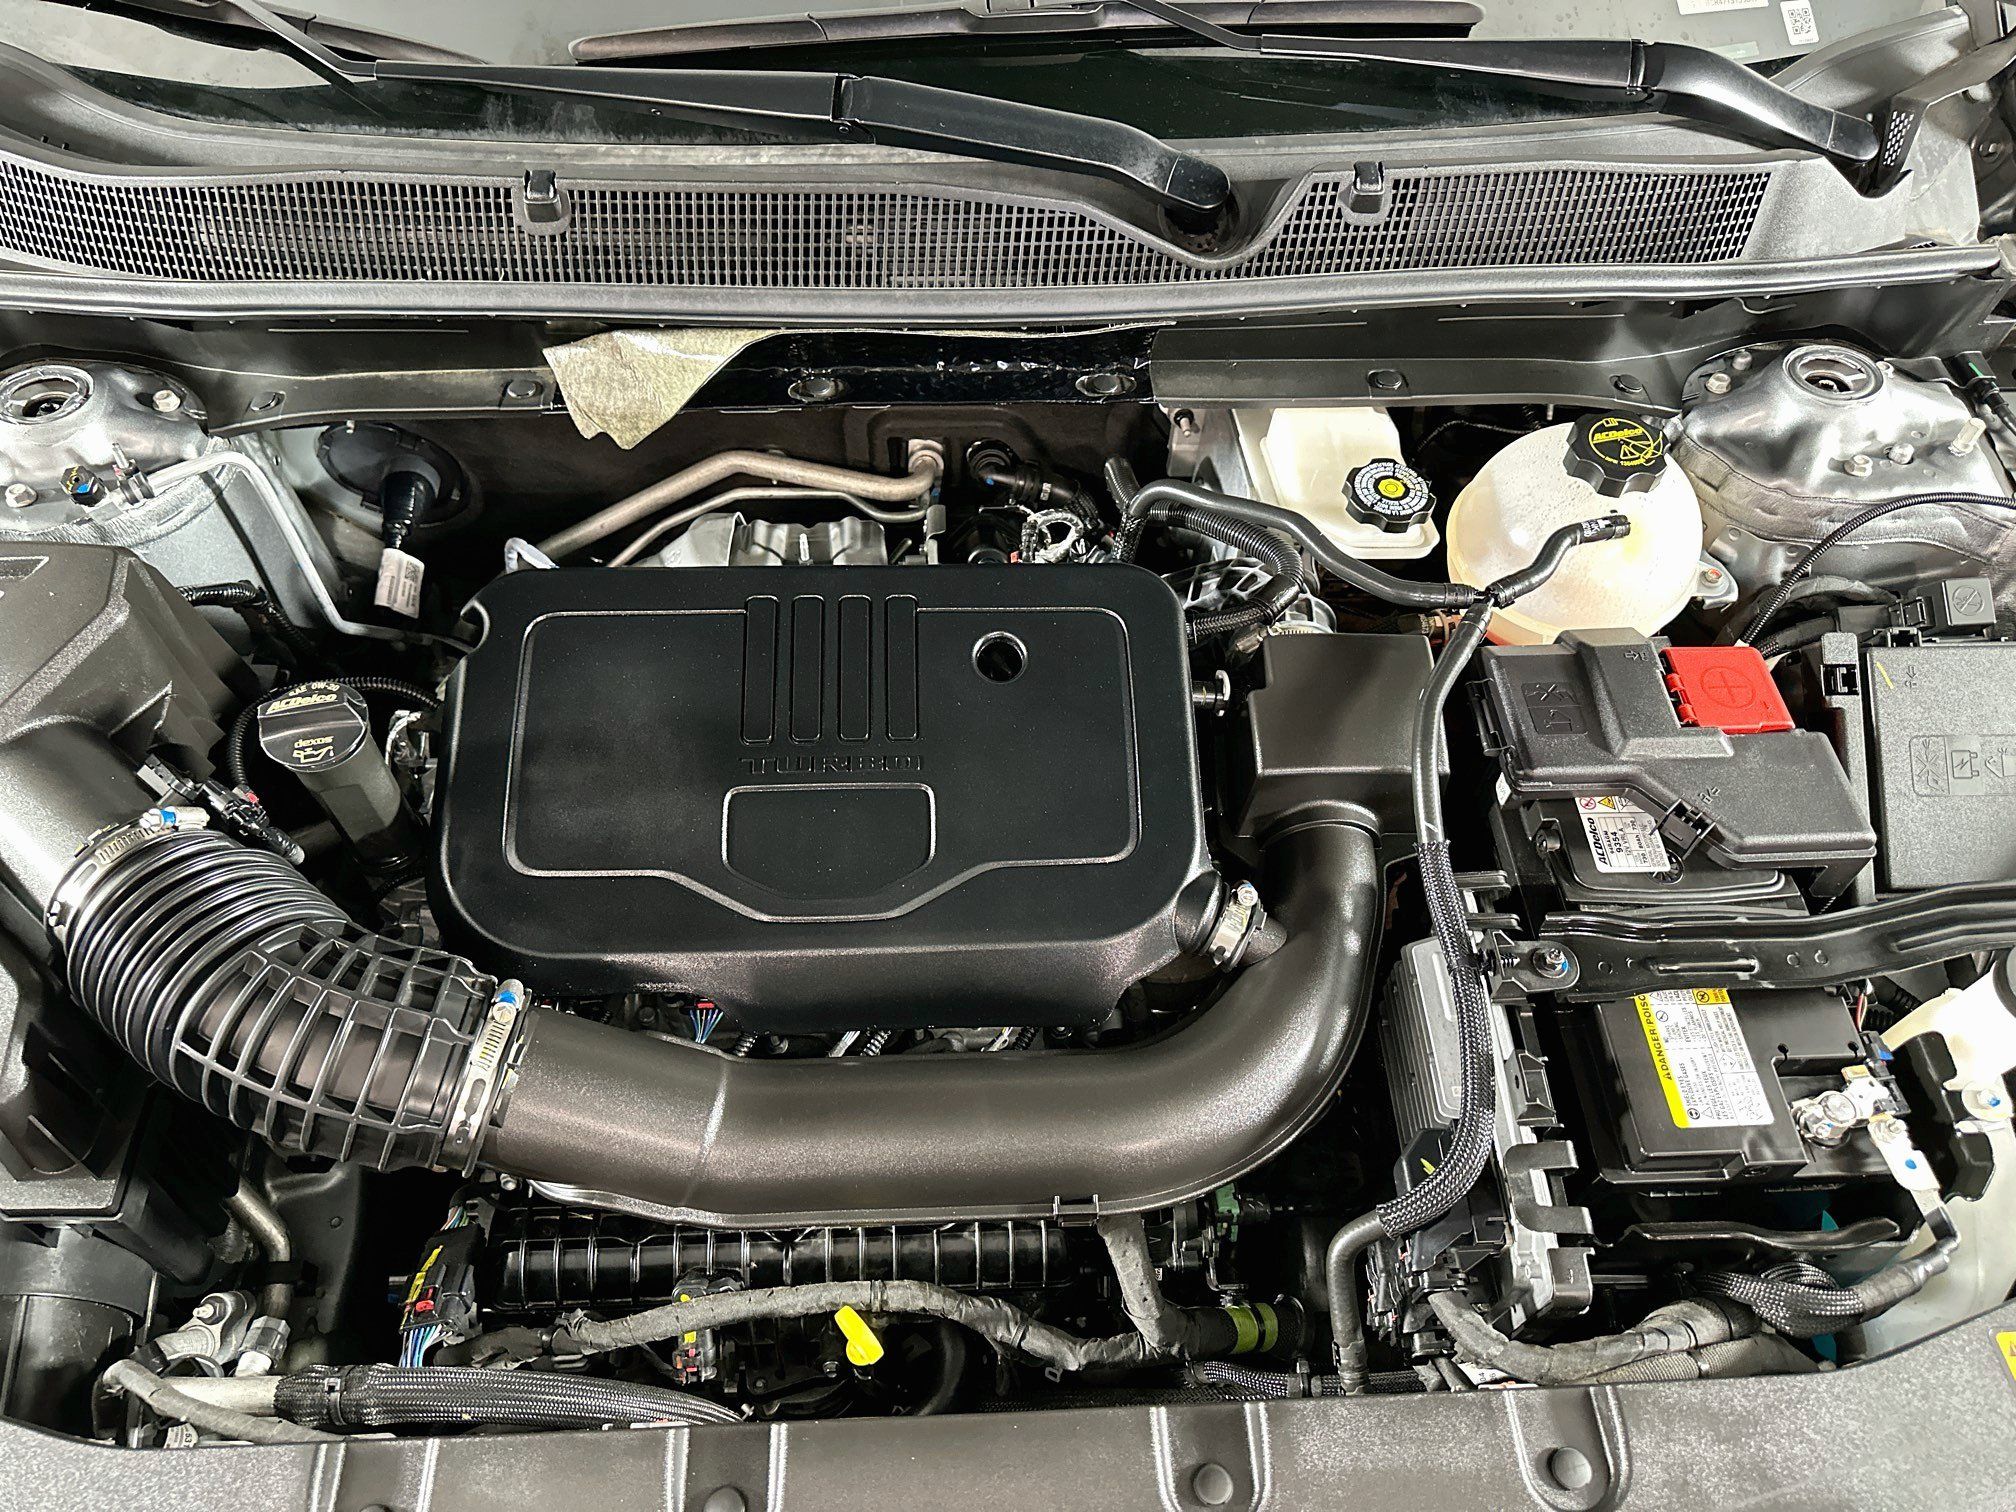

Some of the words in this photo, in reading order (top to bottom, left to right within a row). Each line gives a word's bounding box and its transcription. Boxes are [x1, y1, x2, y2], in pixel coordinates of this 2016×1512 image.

[311, 682, 340, 692] 0W-20
[266, 694, 338, 713] ACDelco
[294, 736, 334, 749] dexos
[738, 756, 922, 775] TURBO
[1588, 818, 1607, 864] ACDelco
[1611, 832, 1623, 853] 9354
